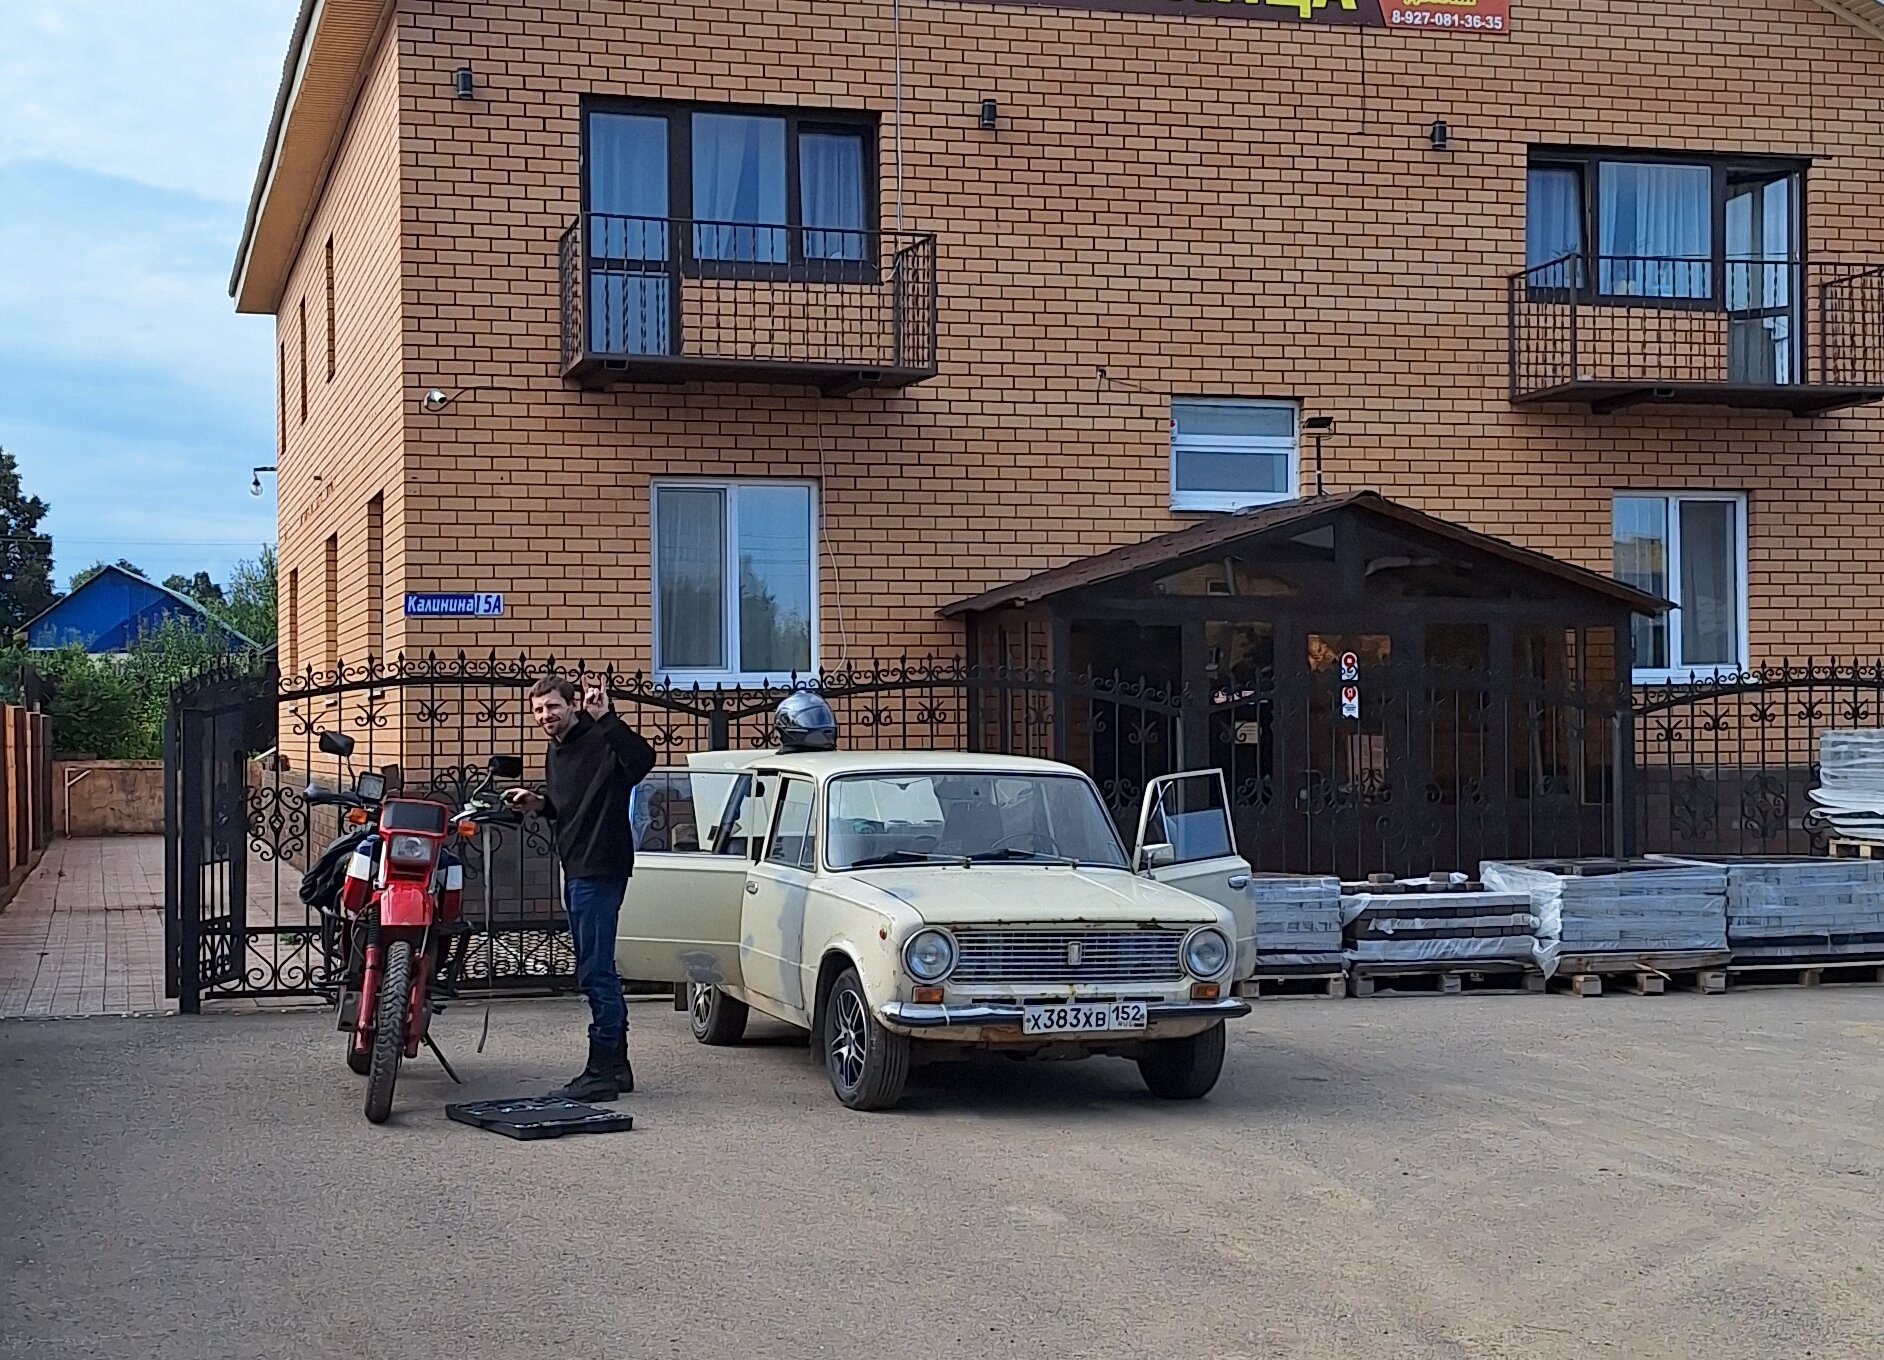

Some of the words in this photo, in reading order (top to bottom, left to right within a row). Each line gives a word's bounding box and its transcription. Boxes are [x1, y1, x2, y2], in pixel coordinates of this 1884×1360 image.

[1391, 9, 1503, 30] 8-927-081-36-35
[407, 595, 474, 613] Калинина
[1031, 1007, 1106, 1031] Х383ХВ
[1112, 1005, 1141, 1022] 152
